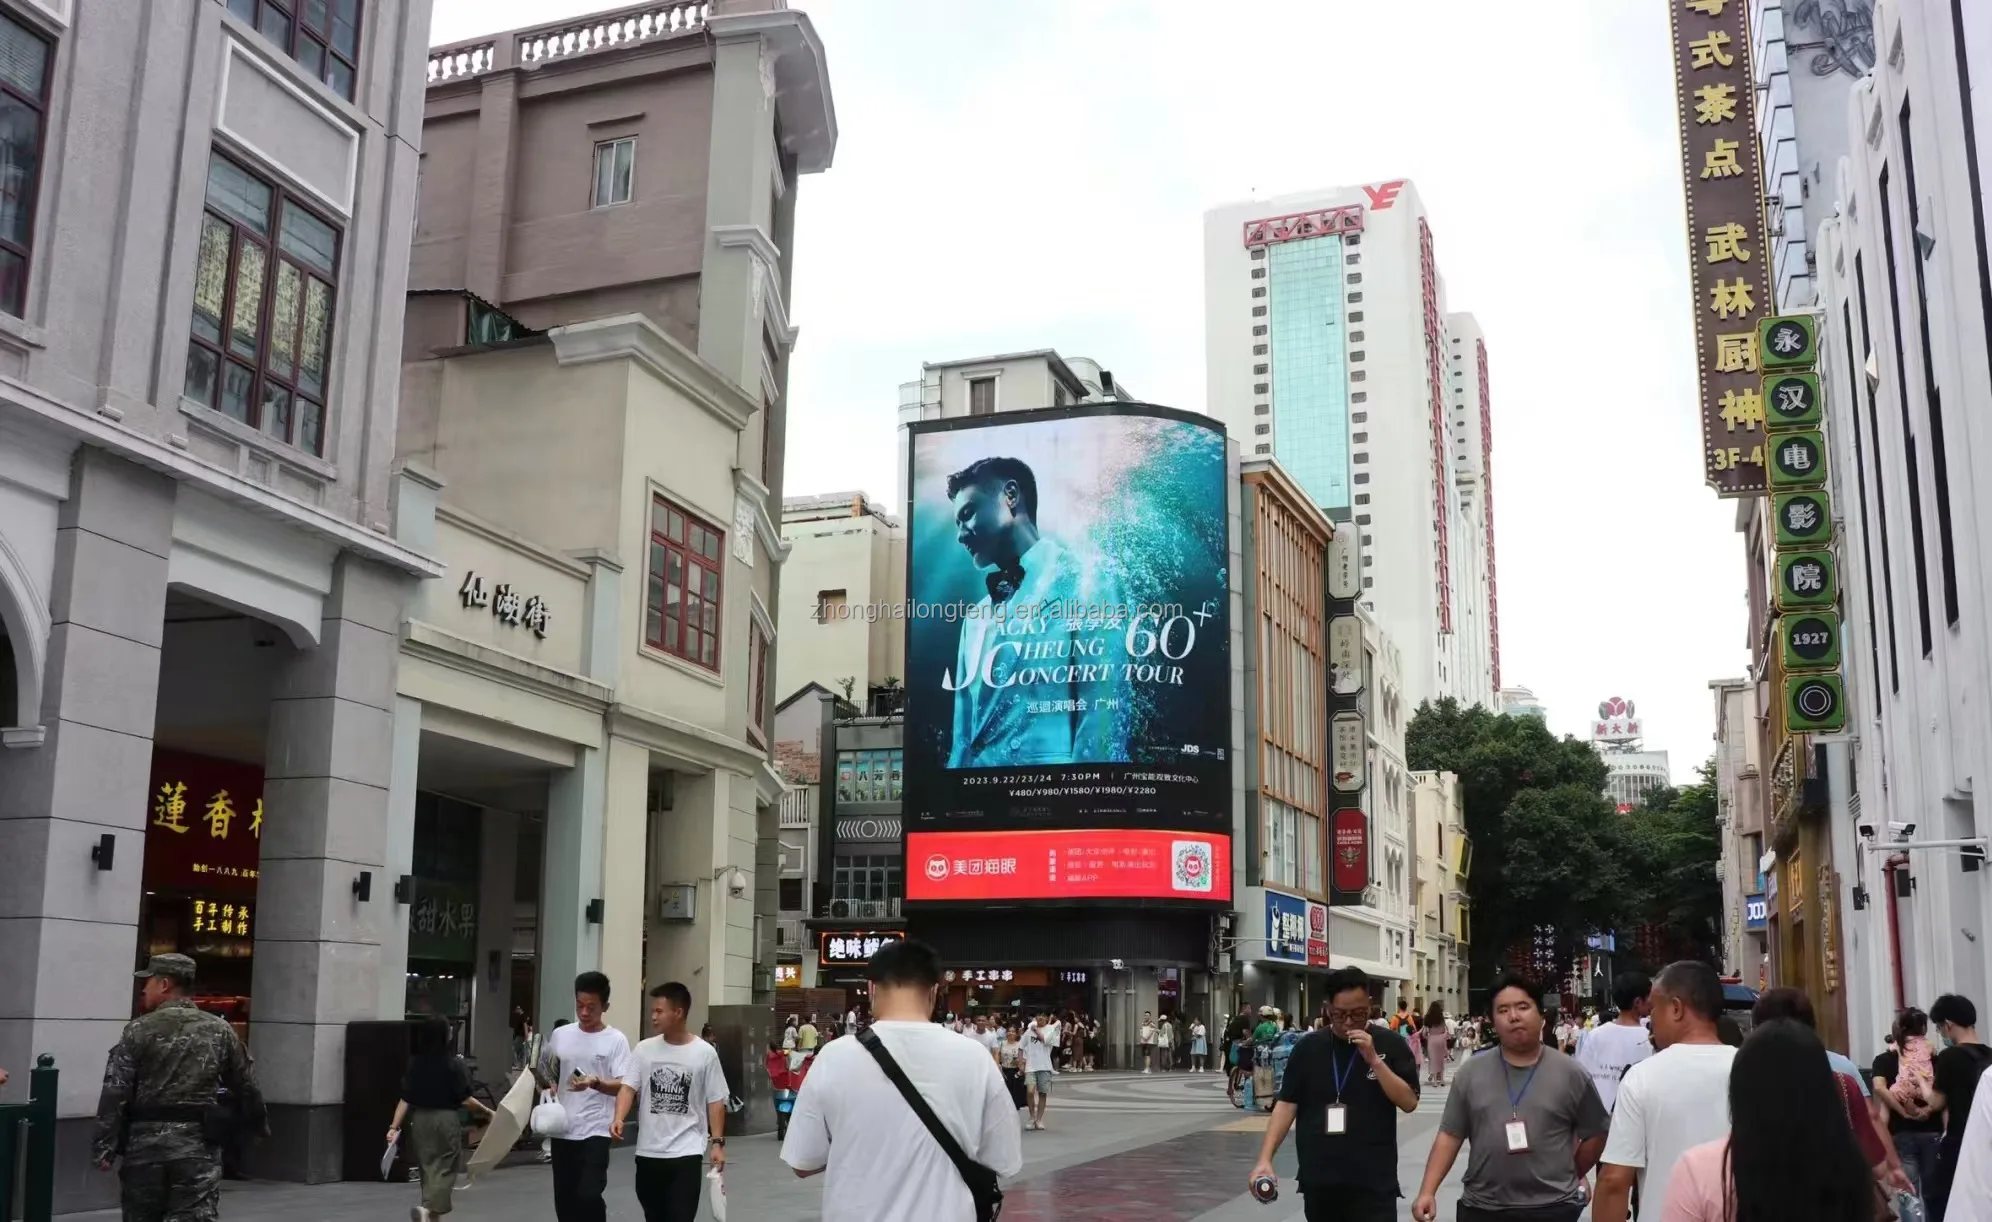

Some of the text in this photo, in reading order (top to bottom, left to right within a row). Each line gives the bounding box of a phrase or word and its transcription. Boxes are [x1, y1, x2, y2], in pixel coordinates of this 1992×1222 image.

[1704, 223, 1762, 432] 武林厨神
[1773, 328, 1822, 591] 永汉电影院
[459, 570, 551, 640] 仙湖街
[1793, 631, 1829, 646] 1927
[1121, 664, 1184, 685] TOUR
[1094, 698, 1119, 711] 广州
[1595, 722, 1639, 736] 新大新
[1181, 744, 1200, 754] JDS
[963, 772, 1100, 786] 2023.9.22/23/24 7:30PM
[952, 857, 1017, 876] 美团猫眼
[195, 900, 249, 920] 百年传承
[193, 917, 248, 936] 手工制作
[961, 969, 1013, 982] 手工串串
